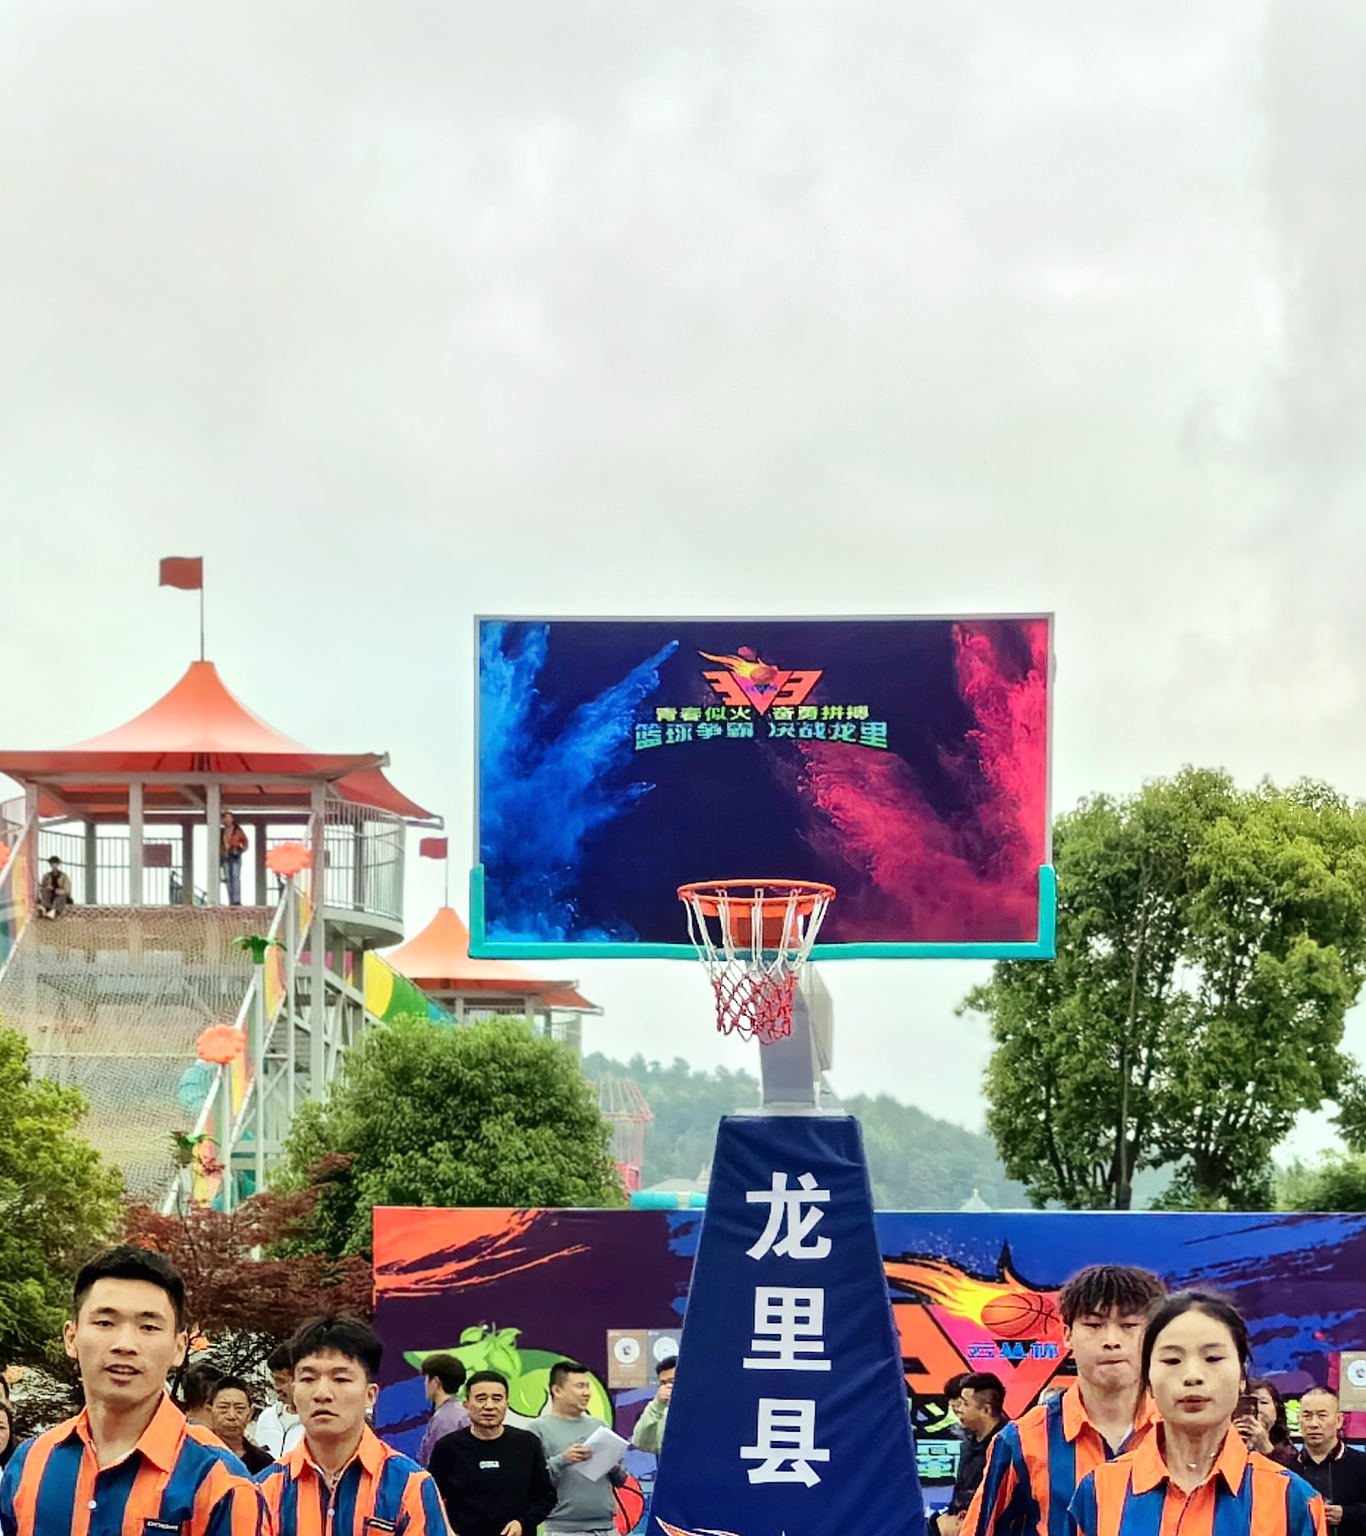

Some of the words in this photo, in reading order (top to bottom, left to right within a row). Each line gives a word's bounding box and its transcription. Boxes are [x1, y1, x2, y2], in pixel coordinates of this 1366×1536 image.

[656, 706, 752, 722] 青春似火
[771, 705, 870, 722] 奋勇拼搏
[635, 722, 754, 751] 篮球争霸
[768, 721, 888, 749] 决战龙里
[739, 1171, 833, 1488] 龙里县
